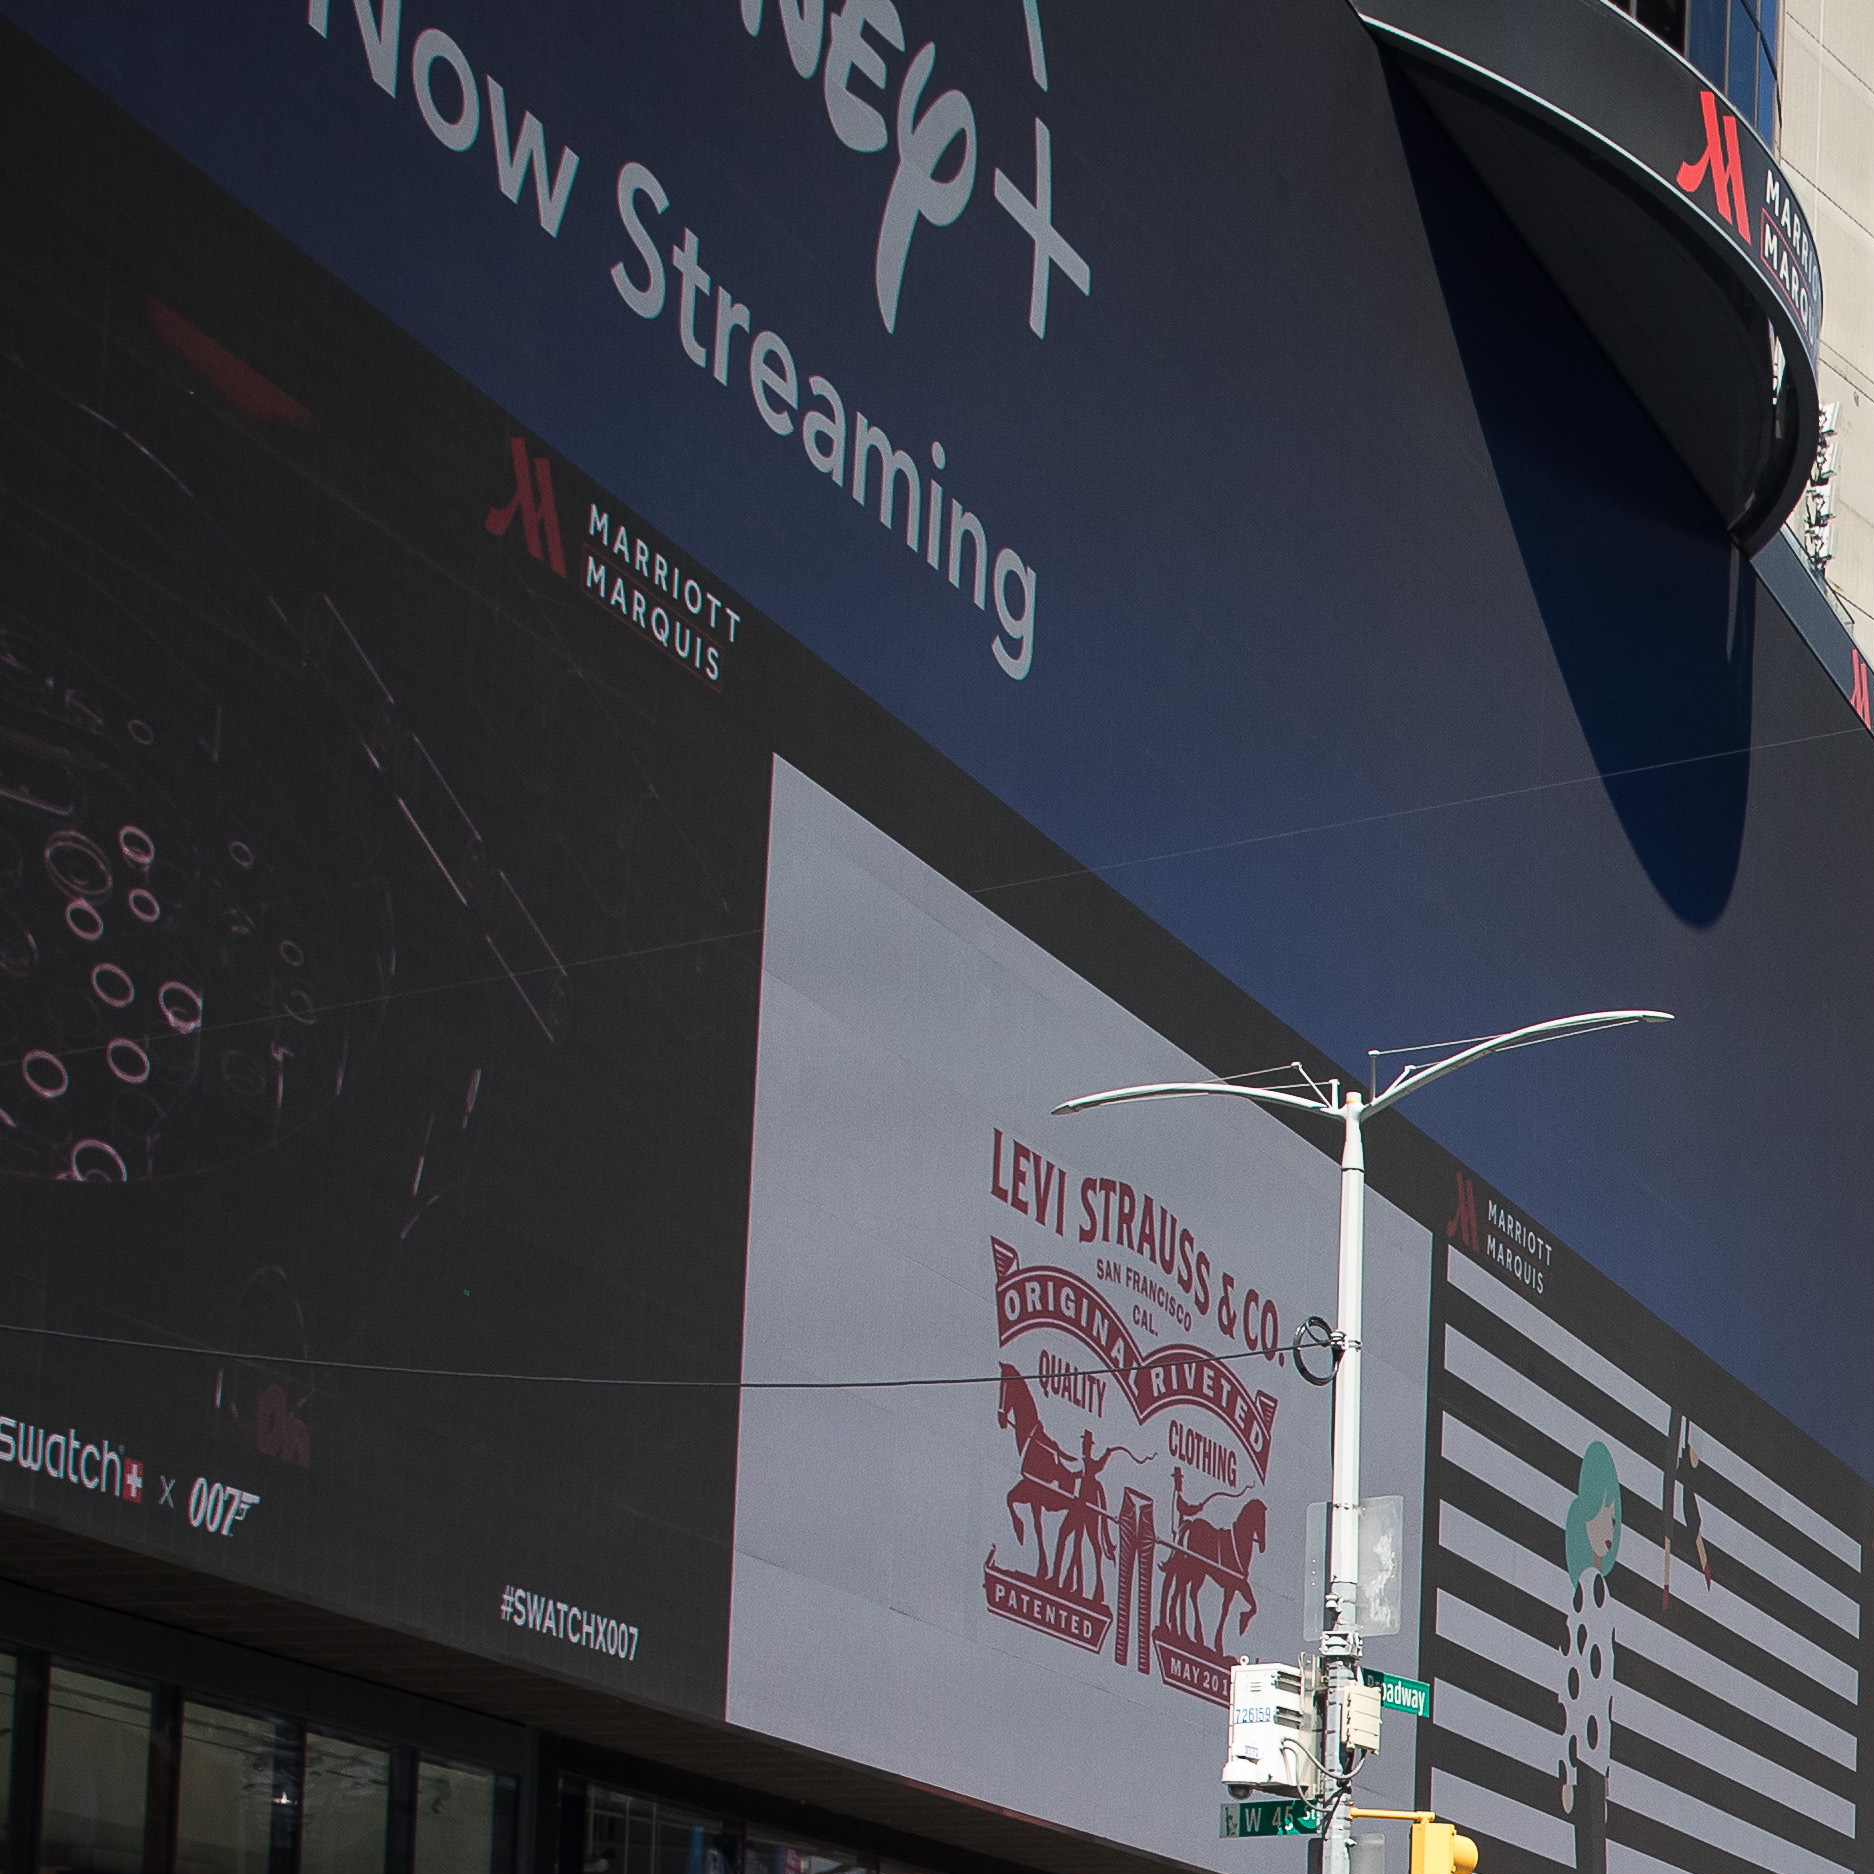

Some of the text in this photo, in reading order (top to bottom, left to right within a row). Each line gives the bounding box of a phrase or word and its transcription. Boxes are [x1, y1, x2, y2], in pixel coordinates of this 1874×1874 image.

[610, 161, 1037, 680] Streaming
[587, 502, 741, 643] MARRIOTT
[586, 555, 722, 682] MARQUIS
[991, 1127, 1286, 1368] LEVI STRAUSS & CO.
[1486, 1233, 1545, 1295] MARQUIS
[1488, 1199, 1553, 1267] MARRIOTT
[1003, 1280, 1140, 1386] ORIGINAL
[1096, 1258, 1193, 1334] SAN FRANCISCO
[1132, 1304, 1160, 1338] CAL.
[1037, 1349, 1107, 1419] QUALITY
[1150, 1362, 1264, 1455] RIVETED
[0, 1415, 123, 1498] swatch
[188, 1476, 260, 1537] 007
[1168, 1418, 1238, 1489] CLOTHING
[501, 1584, 640, 1662] #SWATCHX007
[994, 1583, 1095, 1640] PATENTED
[1170, 1656, 1200, 1684] MAY
[1243, 1807, 1262, 1833] W
[1271, 1805, 1294, 1831] 45
